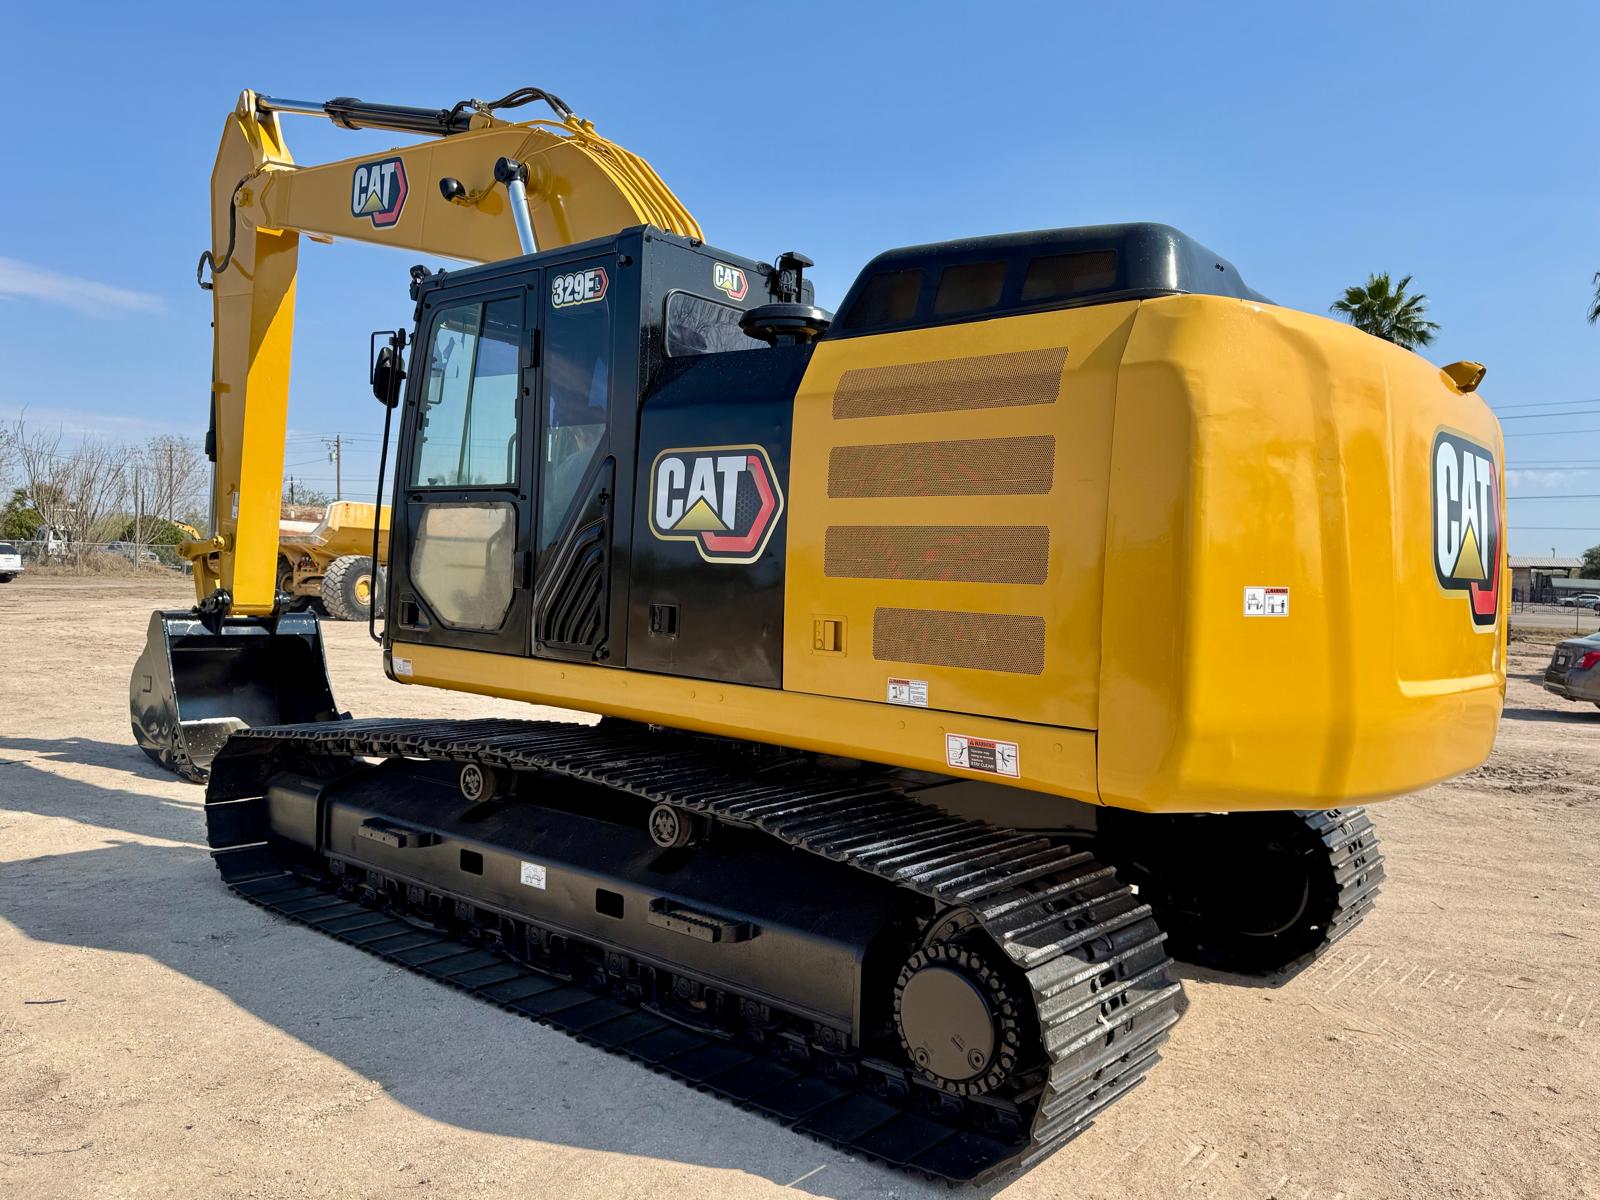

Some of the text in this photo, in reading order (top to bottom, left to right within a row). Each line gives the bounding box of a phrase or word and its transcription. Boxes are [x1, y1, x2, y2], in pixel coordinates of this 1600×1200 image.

[353, 162, 395, 214] CAT
[553, 271, 595, 304] 329E
[715, 265, 739, 291] CAT
[656, 455, 747, 530] CAT
[1436, 441, 1491, 579] CAT
